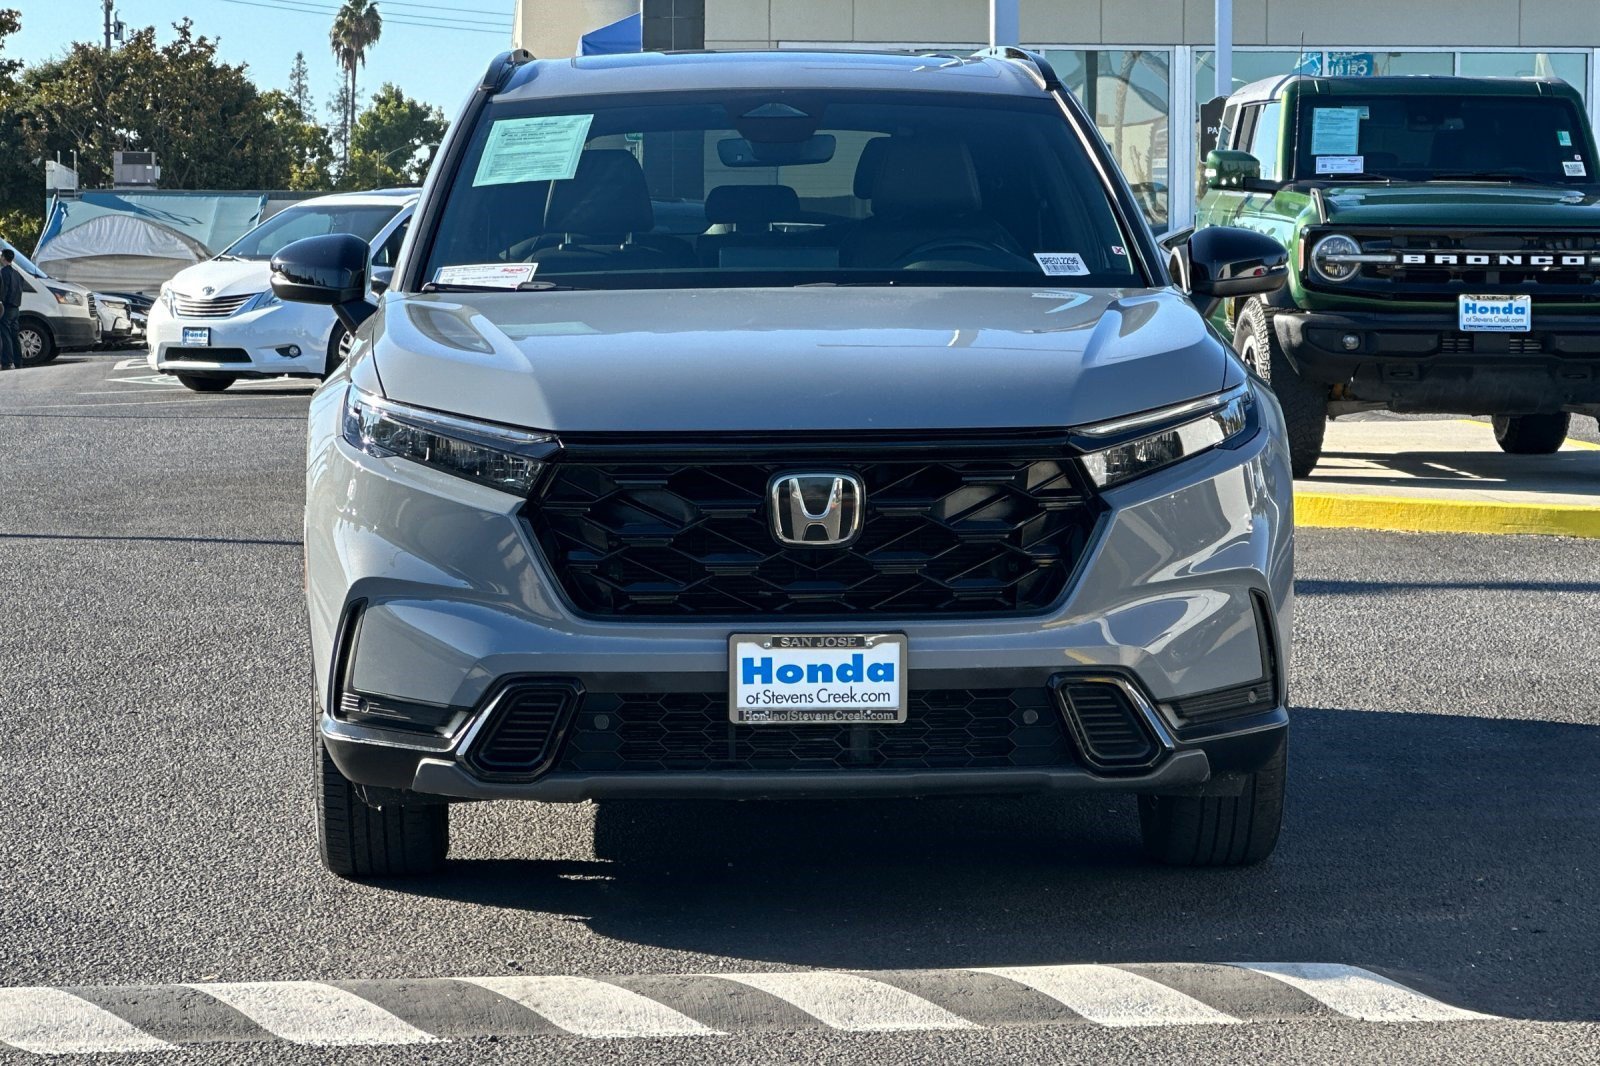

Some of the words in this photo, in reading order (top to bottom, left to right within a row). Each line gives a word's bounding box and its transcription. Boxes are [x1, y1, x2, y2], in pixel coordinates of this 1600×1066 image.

[1403, 254, 1585, 265] BRONCO
[1464, 303, 1525, 314] Honda
[1493, 315, 1524, 323] Creek.com
[780, 637, 812, 647] SAN
[816, 637, 857, 647] JOSE
[742, 653, 894, 684] Honda
[746, 692, 761, 704] of
[763, 689, 813, 704] Stevens
[816, 686, 890, 703] Creek.com
[743, 709, 894, 721] HondaofStevensCreek.com
